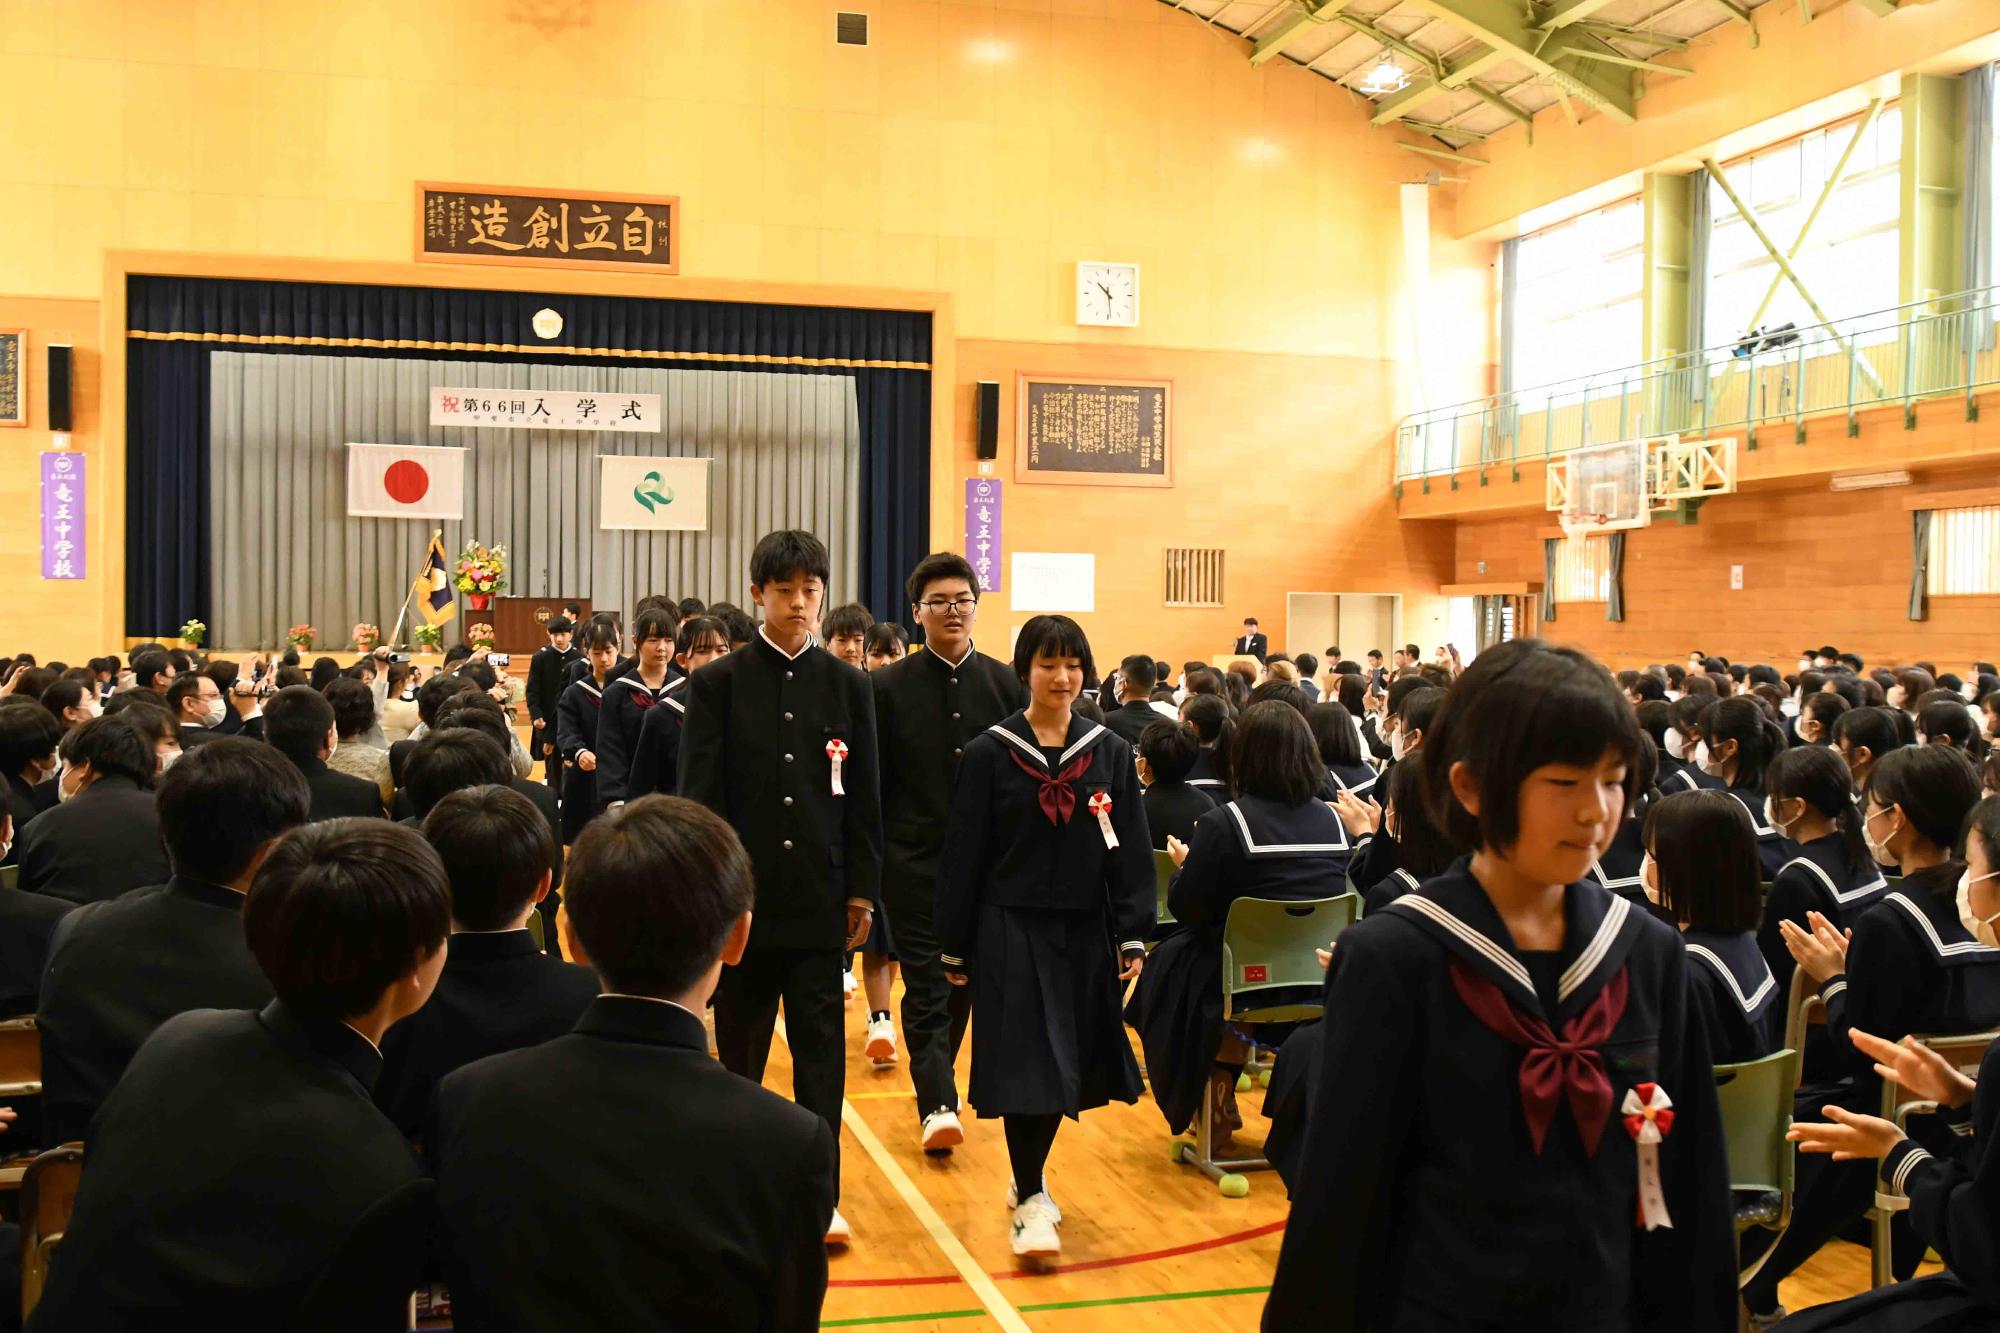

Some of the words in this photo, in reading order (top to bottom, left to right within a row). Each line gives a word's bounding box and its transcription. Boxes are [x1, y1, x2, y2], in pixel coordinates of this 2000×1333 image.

[54, 483, 75, 577] 竜王中学校
[976, 505, 992, 591] 竜王中学校
